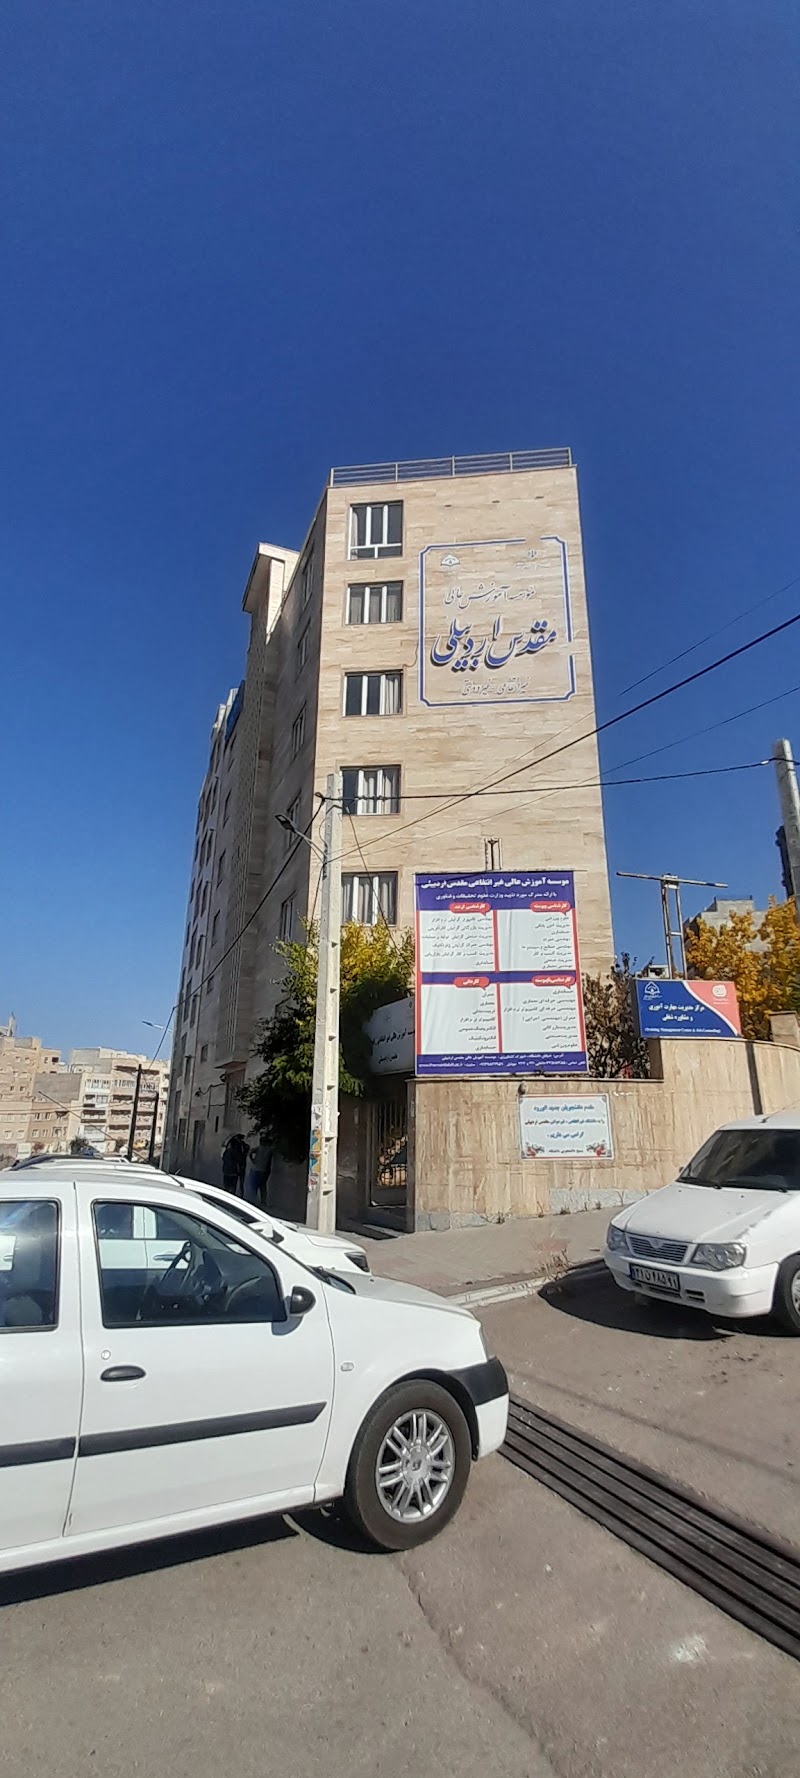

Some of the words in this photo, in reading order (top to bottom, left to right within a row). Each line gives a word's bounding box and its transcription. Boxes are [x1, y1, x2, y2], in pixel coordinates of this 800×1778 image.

[430, 614, 502, 673] اردبیلی
[484, 620, 557, 670] مقدس
[446, 880, 468, 888] مقدس
[468, 879, 492, 887] انتفاعی
[493, 879, 504, 887] غیر
[505, 878, 521, 887] عالی
[522, 877, 546, 887] آموزش
